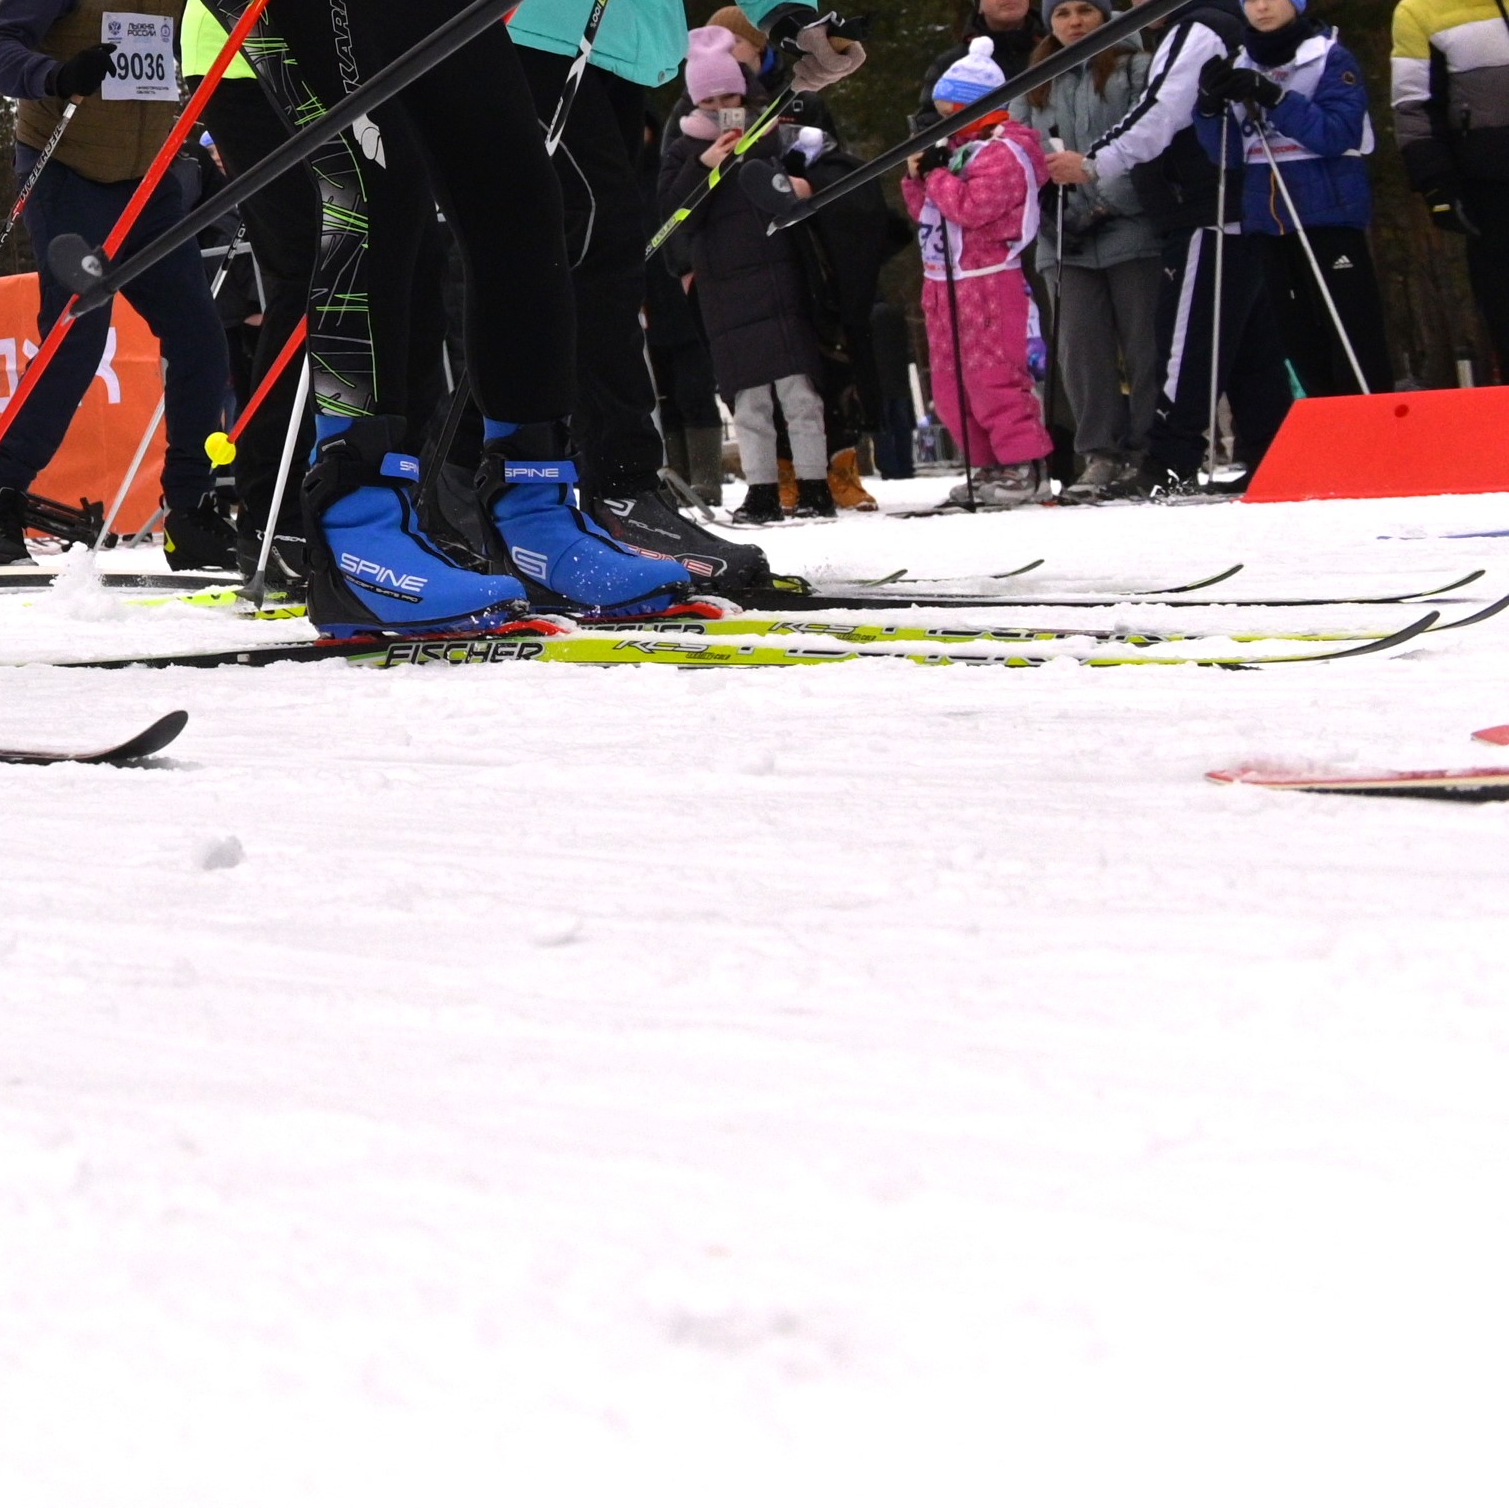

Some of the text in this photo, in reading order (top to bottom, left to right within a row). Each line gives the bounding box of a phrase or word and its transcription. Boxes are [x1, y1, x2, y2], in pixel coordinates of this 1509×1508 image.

[117, 52, 165, 81] 9036
[505, 467, 559, 478] SPINE
[340, 552, 429, 592] SPINE
[401, 593, 419, 603] PRO
[385, 641, 545, 669] FISCHER
